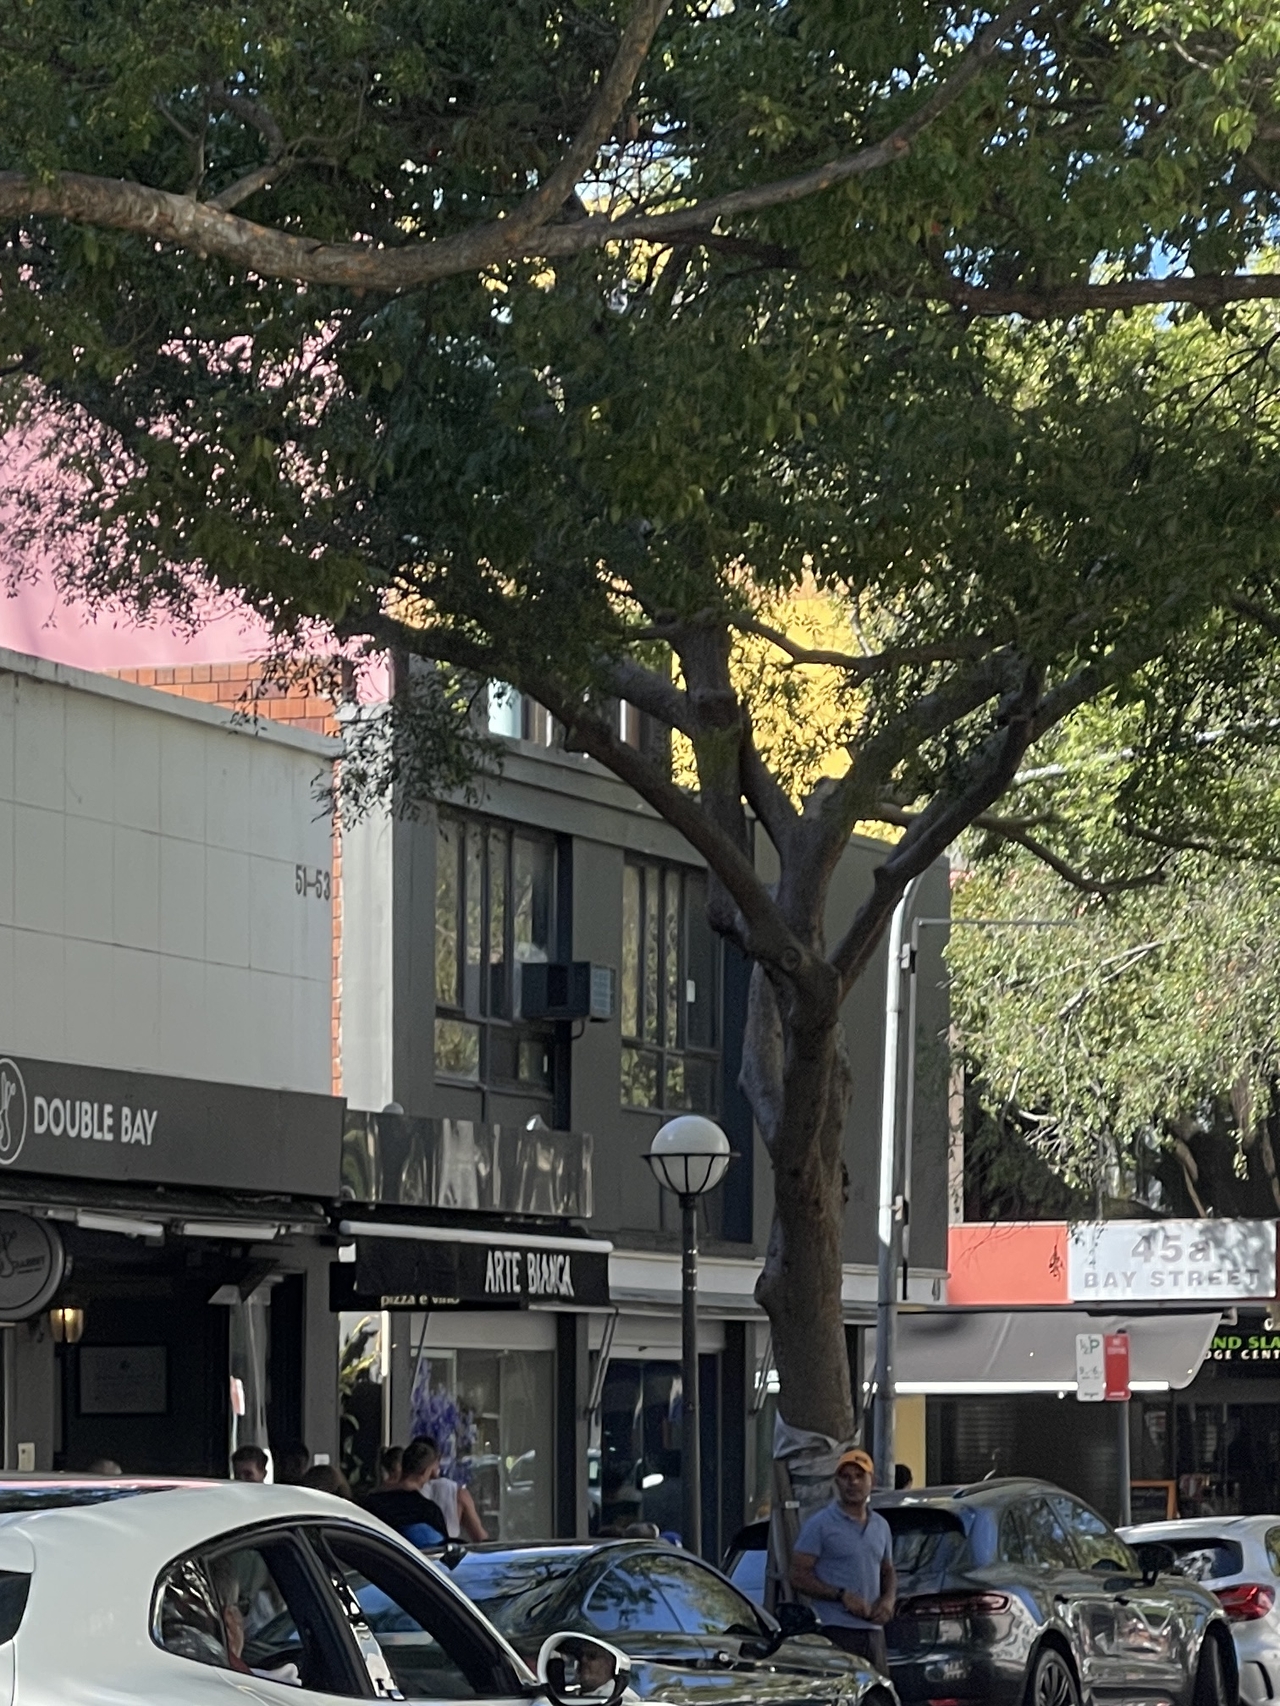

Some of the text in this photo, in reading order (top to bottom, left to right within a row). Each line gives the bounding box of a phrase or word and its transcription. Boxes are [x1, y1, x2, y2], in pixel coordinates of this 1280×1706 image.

[295, 864, 331, 901] 51-53
[34, 1096, 158, 1146] DOUBLE BAY
[1131, 1234, 1212, 1264] 45a
[484, 1250, 574, 1297] ARTE BIANCA
[1084, 1269, 1260, 1288] BAY STREET
[1211, 1336, 1242, 1350] ND
